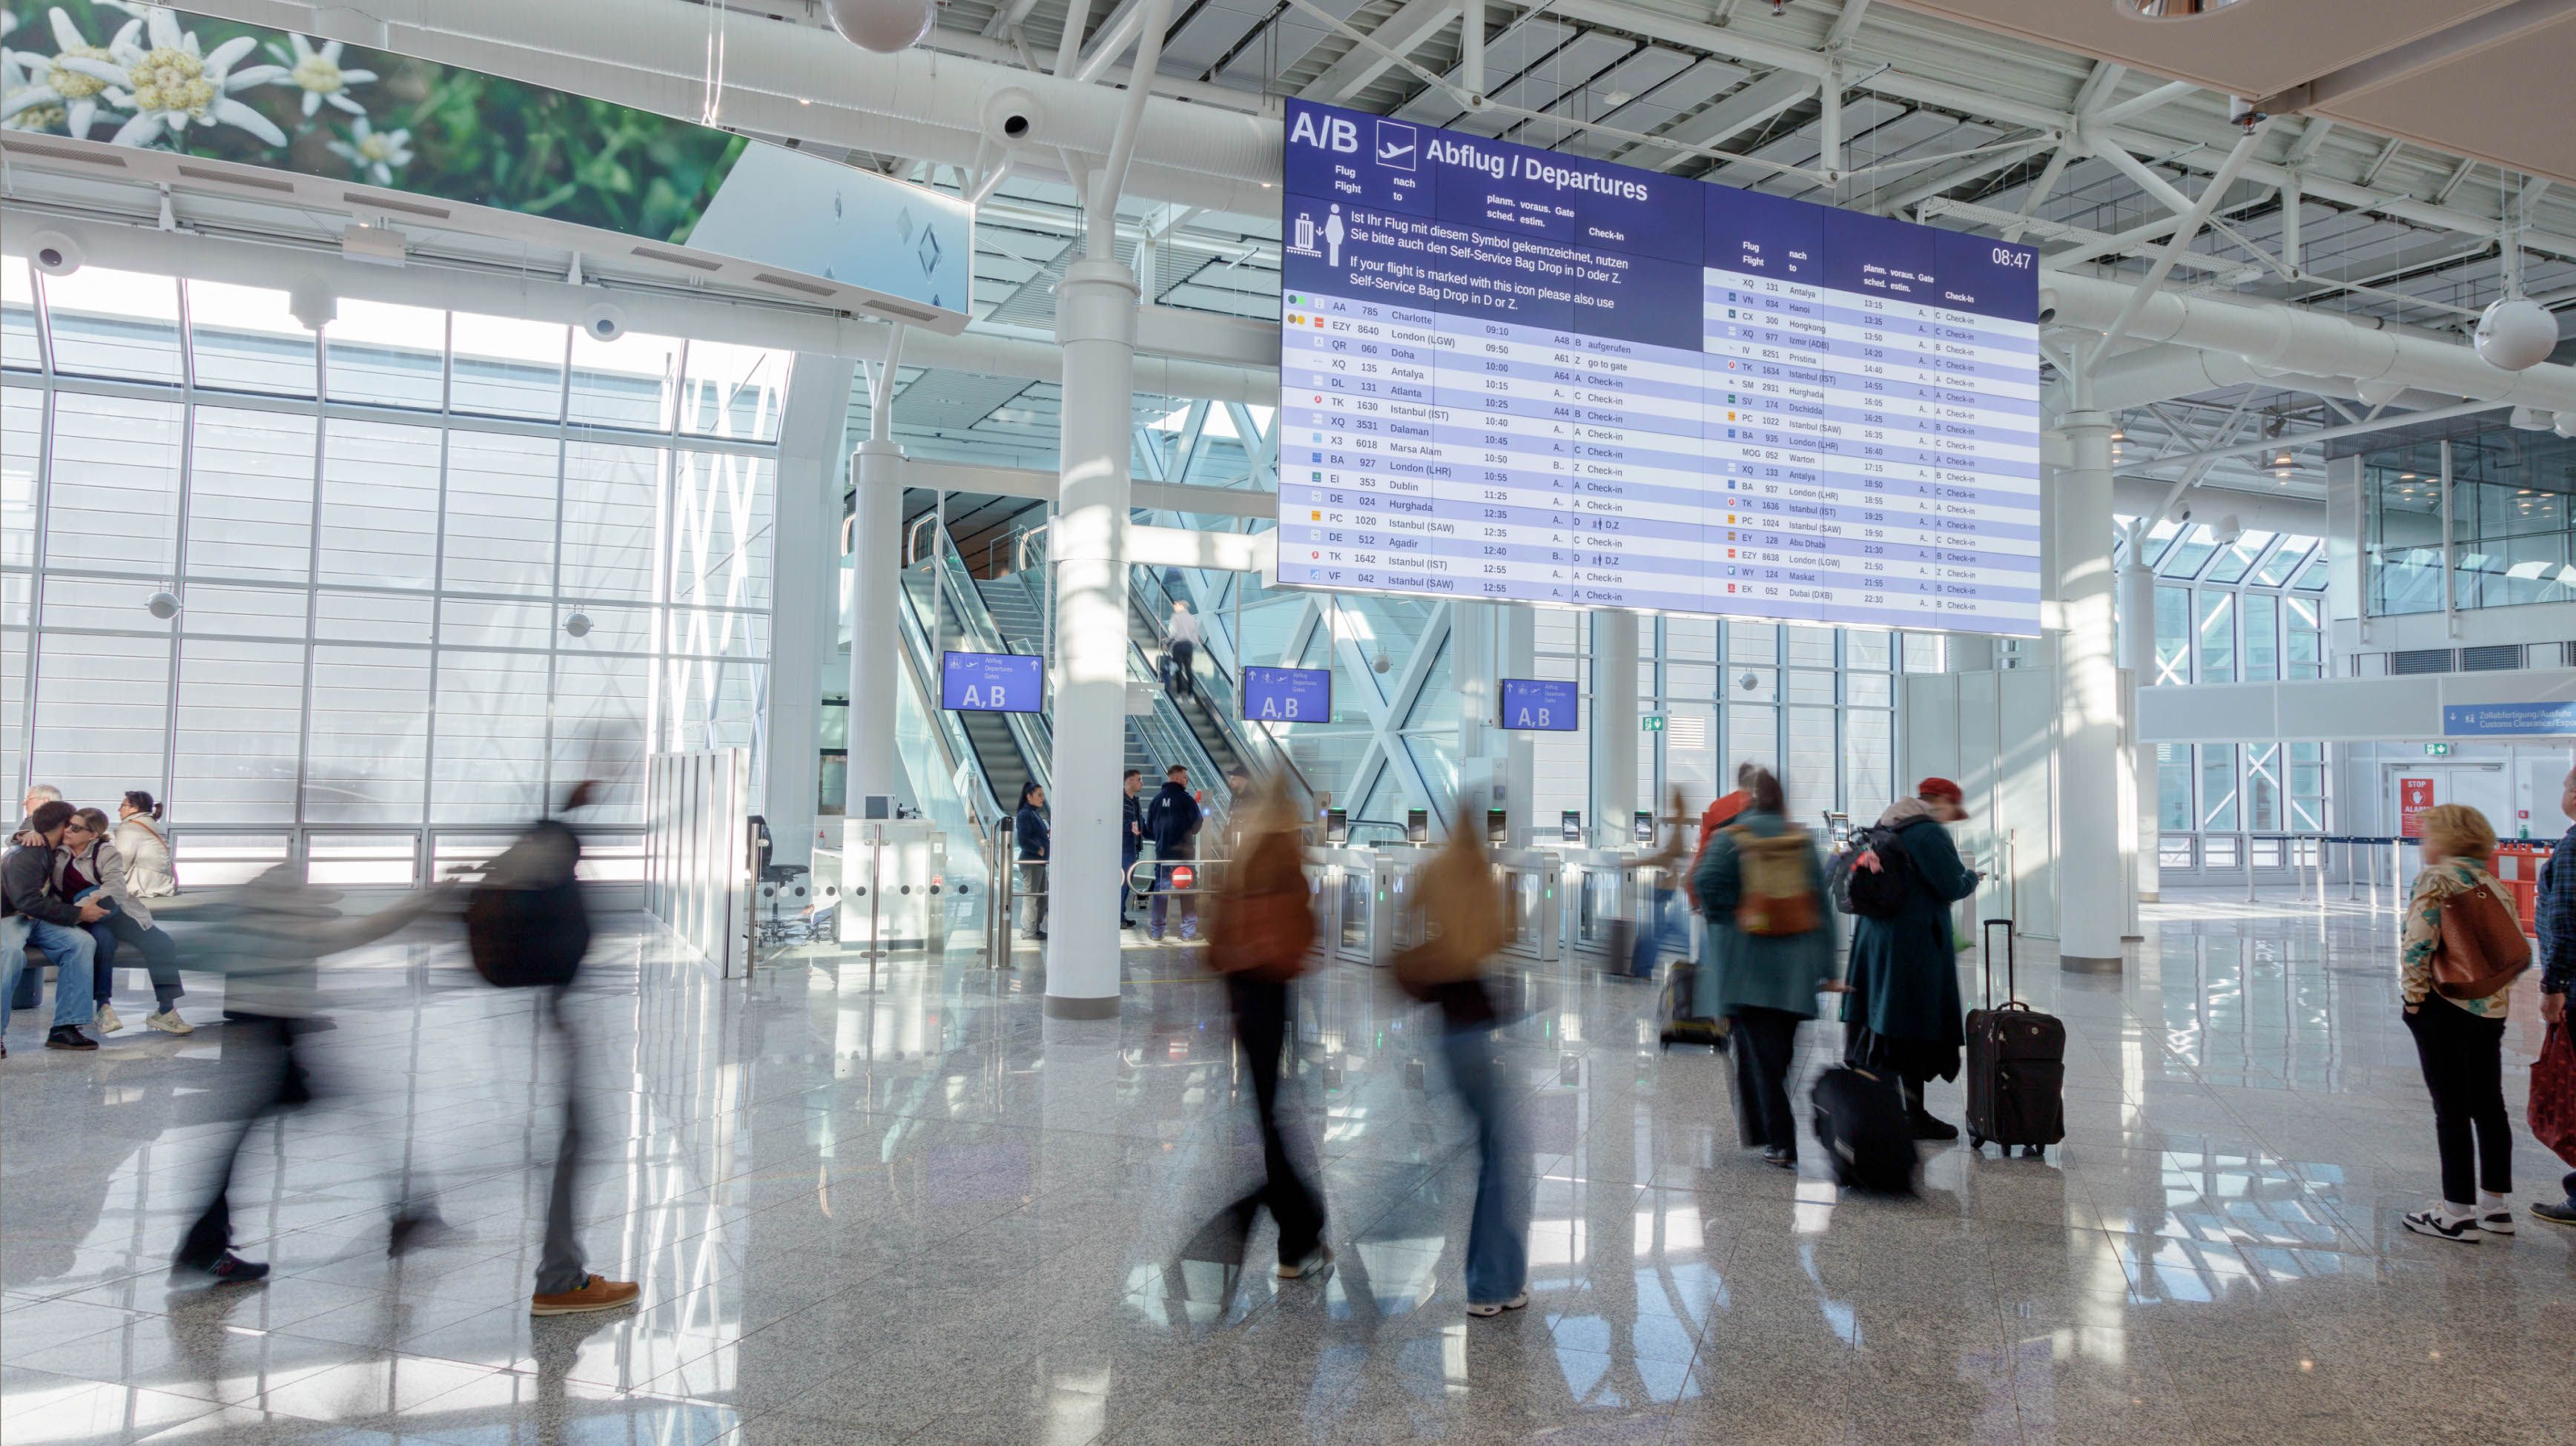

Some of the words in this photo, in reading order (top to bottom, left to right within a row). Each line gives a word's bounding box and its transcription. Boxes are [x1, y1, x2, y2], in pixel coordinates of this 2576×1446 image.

[1289, 111, 1358, 153] A/B
[1425, 139, 1505, 179] Abflug
[1510, 154, 1519, 176] /
[1525, 157, 1648, 201] Departures
[1335, 164, 1356, 179] Flug
[1393, 177, 1416, 188] nach
[1486, 194, 1516, 207] planm.
[1519, 201, 1551, 214] voraus.
[1554, 206, 1574, 217] Gate
[1335, 179, 1361, 194] Flight
[1393, 191, 1403, 202] to
[1487, 210, 1515, 222] sched.
[1519, 216, 1545, 227] estim.
[1588, 227, 1624, 241] Check-In
[1350, 227, 1369, 241] Sie
[1371, 231, 1395, 246] bitte
[1397, 237, 1424, 251] auch
[1426, 241, 1447, 255] den
[1450, 245, 1512, 265] Self-Service
[1514, 256, 1535, 272] Bag
[1537, 260, 1562, 276] Drop
[1564, 263, 1573, 276] in
[1576, 266, 1585, 277] D
[1587, 269, 1610, 282] oder
[1611, 271, 1621, 284] Z.
[1351, 211, 1364, 224] Ist
[1367, 213, 1382, 226] Ihr
[1384, 217, 1409, 234] Flug
[1410, 222, 1428, 235] mit
[1430, 225, 1468, 242] diesem
[1470, 231, 1510, 249] Symbol
[1512, 240, 1593, 265] gekennzeichnet,
[1595, 256, 1628, 269] nutzen
[1992, 247, 2031, 269] 08:47
[1743, 240, 1760, 254] Flug
[1789, 251, 1807, 260] nach
[1863, 263, 1887, 274] planm.
[1889, 268, 1915, 280] voraus.
[1918, 273, 1935, 283] Gate
[1743, 254, 1764, 267] Flight
[1789, 263, 1797, 272] to
[1863, 277, 1886, 288] sched.
[1889, 283, 1911, 292] estim.
[1945, 291, 1974, 303] Check-In
[1350, 255, 1358, 267] If
[1359, 259, 1384, 271] your
[1387, 261, 1413, 277] flight
[1416, 265, 1425, 278] is
[1427, 270, 1467, 285] marked
[1469, 276, 1490, 289] with
[1493, 279, 1512, 292] this
[1514, 282, 1535, 296] icon
[1538, 286, 1571, 302] please
[1573, 292, 1594, 306] also
[1596, 297, 1614, 308] use
[1350, 272, 1416, 294] Self-Service
[1418, 283, 1440, 300] Bag
[1442, 288, 1469, 304] Drop
[1471, 291, 1481, 304] in
[1483, 294, 1493, 306] D
[1494, 297, 1506, 308] or
[1507, 297, 1518, 310] Z.
[1743, 278, 1754, 289] XQ
[1766, 282, 1778, 291] 131
[1789, 286, 1816, 299] Antalya
[1864, 299, 1883, 309] 13:15
[1332, 301, 1346, 311] AA
[1362, 306, 1378, 317] 785
[1391, 310, 1433, 325] Charlotte
[1485, 325, 1509, 336] 09:10
[1553, 335, 1570, 345] A48
[1588, 341, 1631, 354] aufgerufen
[1332, 320, 1351, 331] EZY
[1357, 324, 1379, 335] 8640
[1391, 329, 1425, 343] London
[1427, 334, 1455, 349] (LGW)
[1485, 343, 1509, 354] 09:50
[1553, 353, 1569, 363] A61
[1588, 359, 1599, 369] go
[1599, 360, 1608, 369] to
[1610, 363, 1628, 372] gate
[1332, 340, 1347, 351] QR
[1361, 343, 1378, 354] 060
[1391, 348, 1415, 360] Doha
[1485, 361, 1508, 372] 10:00
[1553, 371, 1570, 380] A64
[1332, 358, 1346, 371] XQ
[1361, 363, 1377, 373] 135
[1390, 366, 1424, 380] Antalya
[1485, 379, 1508, 390] 10:15
[1330, 397, 1344, 407] TK
[1357, 400, 1378, 411] 1630
[1390, 404, 1426, 417] Istanbul
[1427, 409, 1449, 422] (IST)
[1484, 416, 1508, 427] 10:40
[1331, 377, 1345, 388] DL
[1361, 381, 1377, 392] 131
[1390, 386, 1421, 398] Atlanta
[1485, 397, 1508, 409] 10:25
[1553, 406, 1569, 417] A44
[1330, 417, 1345, 429] XQ
[1356, 419, 1378, 430] 3531
[1390, 423, 1429, 436] Dalaman
[1484, 435, 1508, 446] 10:45
[1330, 454, 1344, 464] BA
[1359, 458, 1376, 467] 927
[1390, 461, 1424, 473] London
[1425, 465, 1451, 478] (LHR)
[1484, 472, 1507, 482] 10:55
[1742, 448, 1760, 458] MOG
[1765, 450, 1778, 460] 052
[1789, 453, 1815, 463] Warton
[1864, 462, 1883, 472] 17:15
[1330, 474, 1339, 483] EI
[1359, 477, 1375, 487] 353
[1390, 480, 1419, 491] Dublin
[1484, 490, 1507, 501] 11:25
[1330, 493, 1344, 503] DE
[1358, 496, 1375, 506] 024
[1389, 499, 1433, 512] Hurghada
[1484, 509, 1507, 519] 12:35
[1329, 532, 1343, 542] DE
[1358, 535, 1375, 544] 512
[1388, 537, 1419, 549] Agadir
[1484, 546, 1507, 556] 12:40
[1328, 570, 1341, 580] VF
[1358, 573, 1374, 583] 042
[1388, 575, 1424, 587] Istanbul
[1426, 578, 1453, 591] (SAW)
[1483, 583, 1506, 592] 12:55
[1742, 584, 1753, 593] EK
[1765, 587, 1778, 595] 052
[1789, 588, 1810, 598] Dubai
[1811, 590, 1833, 601] (DXB)
[1863, 594, 1883, 604] 22:30
[1162, 798, 1170, 807] M
